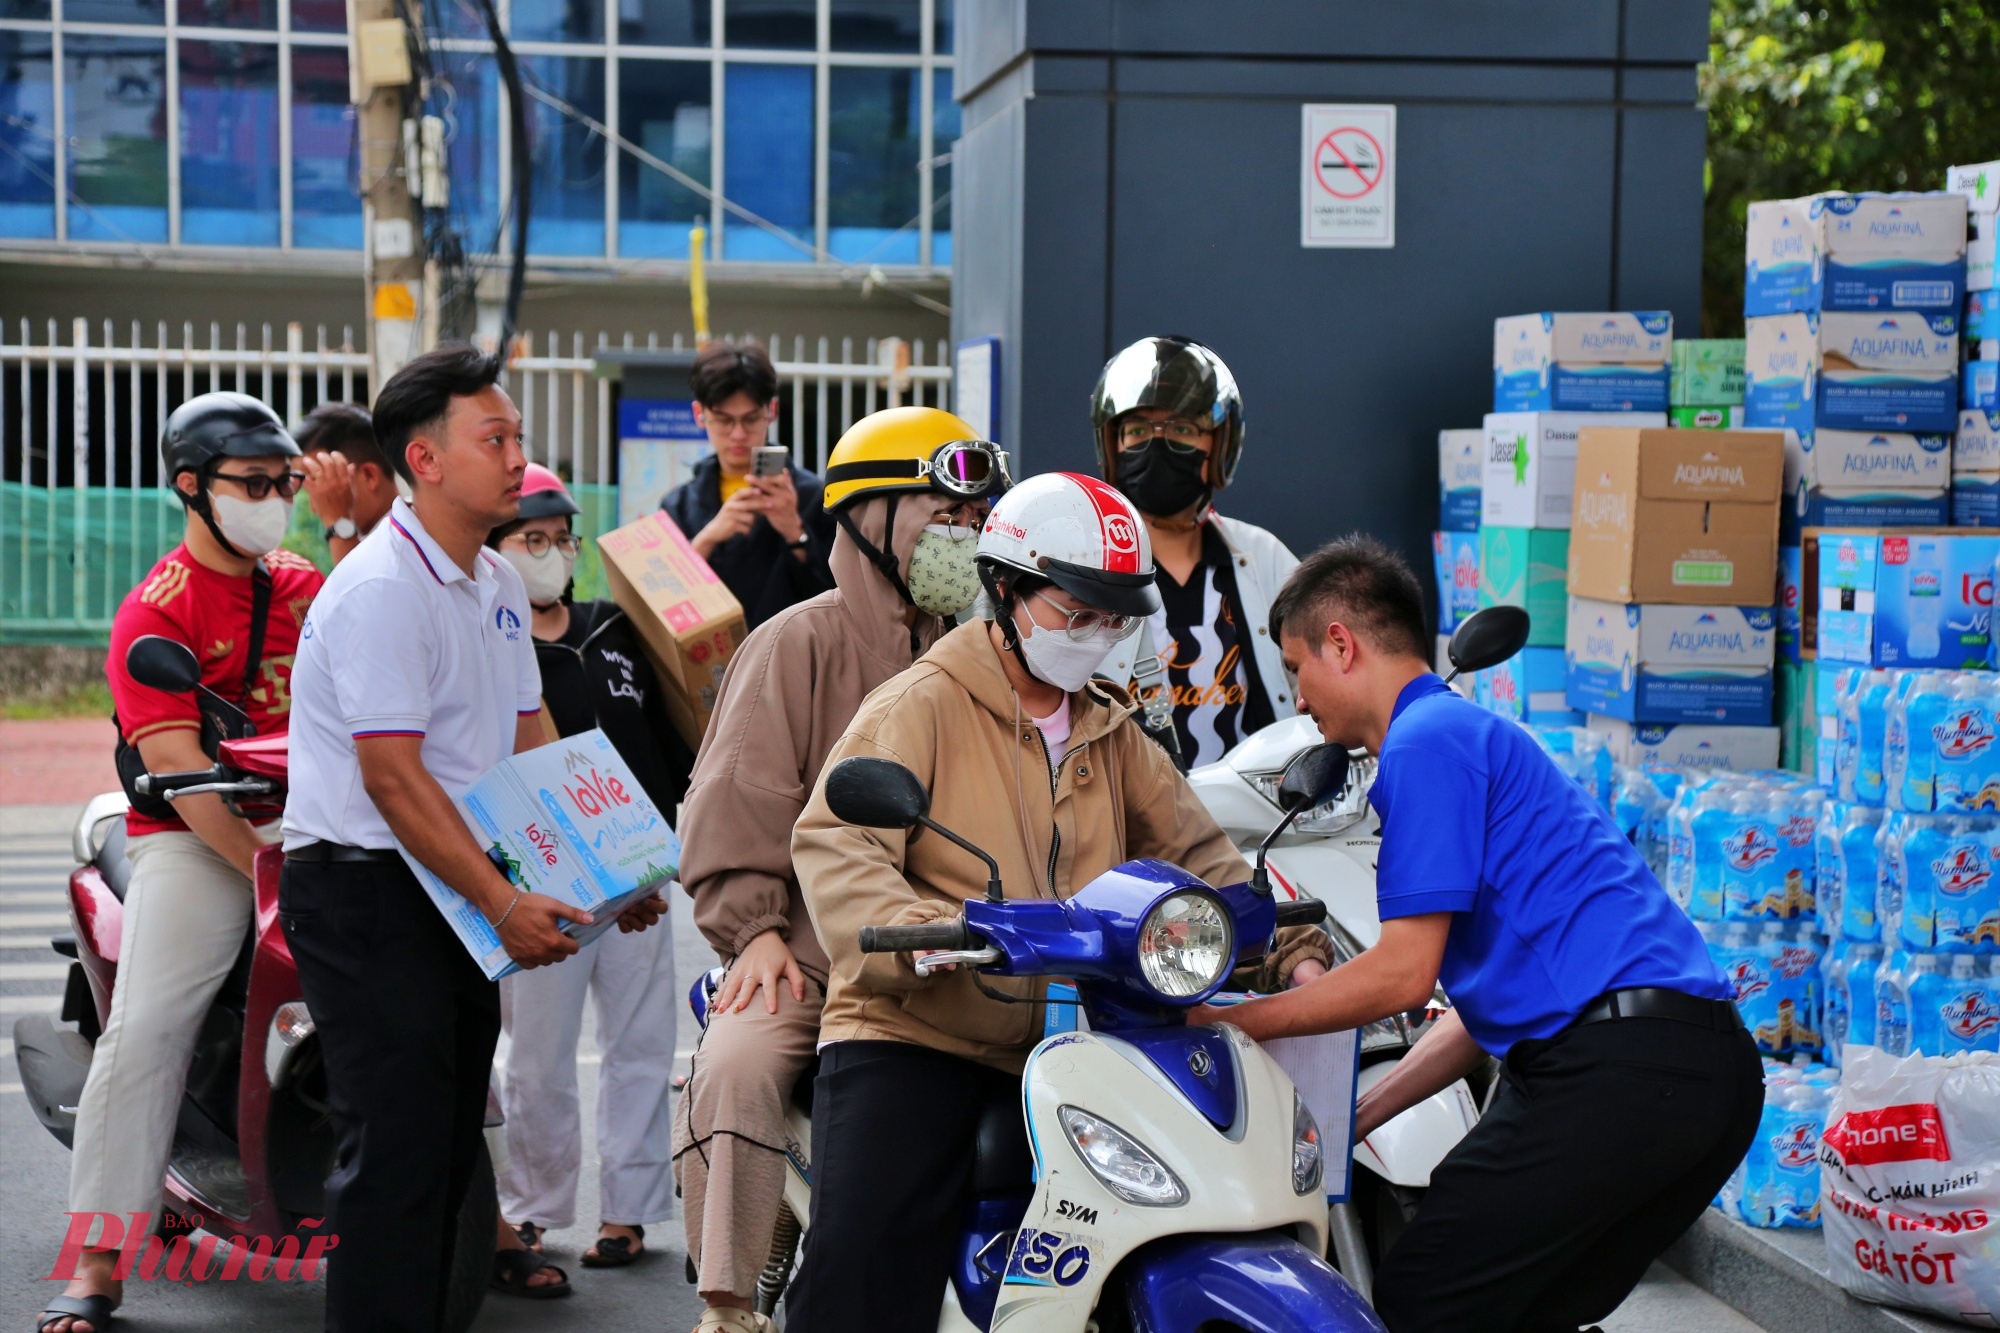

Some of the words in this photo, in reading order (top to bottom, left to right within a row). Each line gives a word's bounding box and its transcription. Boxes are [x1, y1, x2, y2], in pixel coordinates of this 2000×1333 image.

[1869, 221, 1924, 236] AQUAFINA
[1581, 332, 1641, 349] AQUAFINA
[1850, 338, 1929, 359] AQUAFINA
[1546, 428, 1579, 440] Dasa
[1673, 463, 1746, 487] AQUAFINA
[1843, 454, 1920, 475] AQUAFINA
[1577, 488, 1628, 532] AQUAFINA
[1668, 631, 1746, 653] AQUAFINA
[1933, 721, 1985, 742] Number
[1677, 752, 1734, 769] AQUAFINA
[562, 768, 631, 818] laVie
[525, 822, 558, 867] laVie
[1722, 839, 1768, 855] Number
[1932, 857, 1982, 876] Number
[1942, 1003, 1992, 1020] Number
[1772, 1134, 1816, 1151] Numbe
[1845, 1123, 1918, 1147] hone
[1055, 1199, 1098, 1225] SYM
[1022, 1230, 1091, 1287] 50
[1893, 1241, 1956, 1285] TỐT
